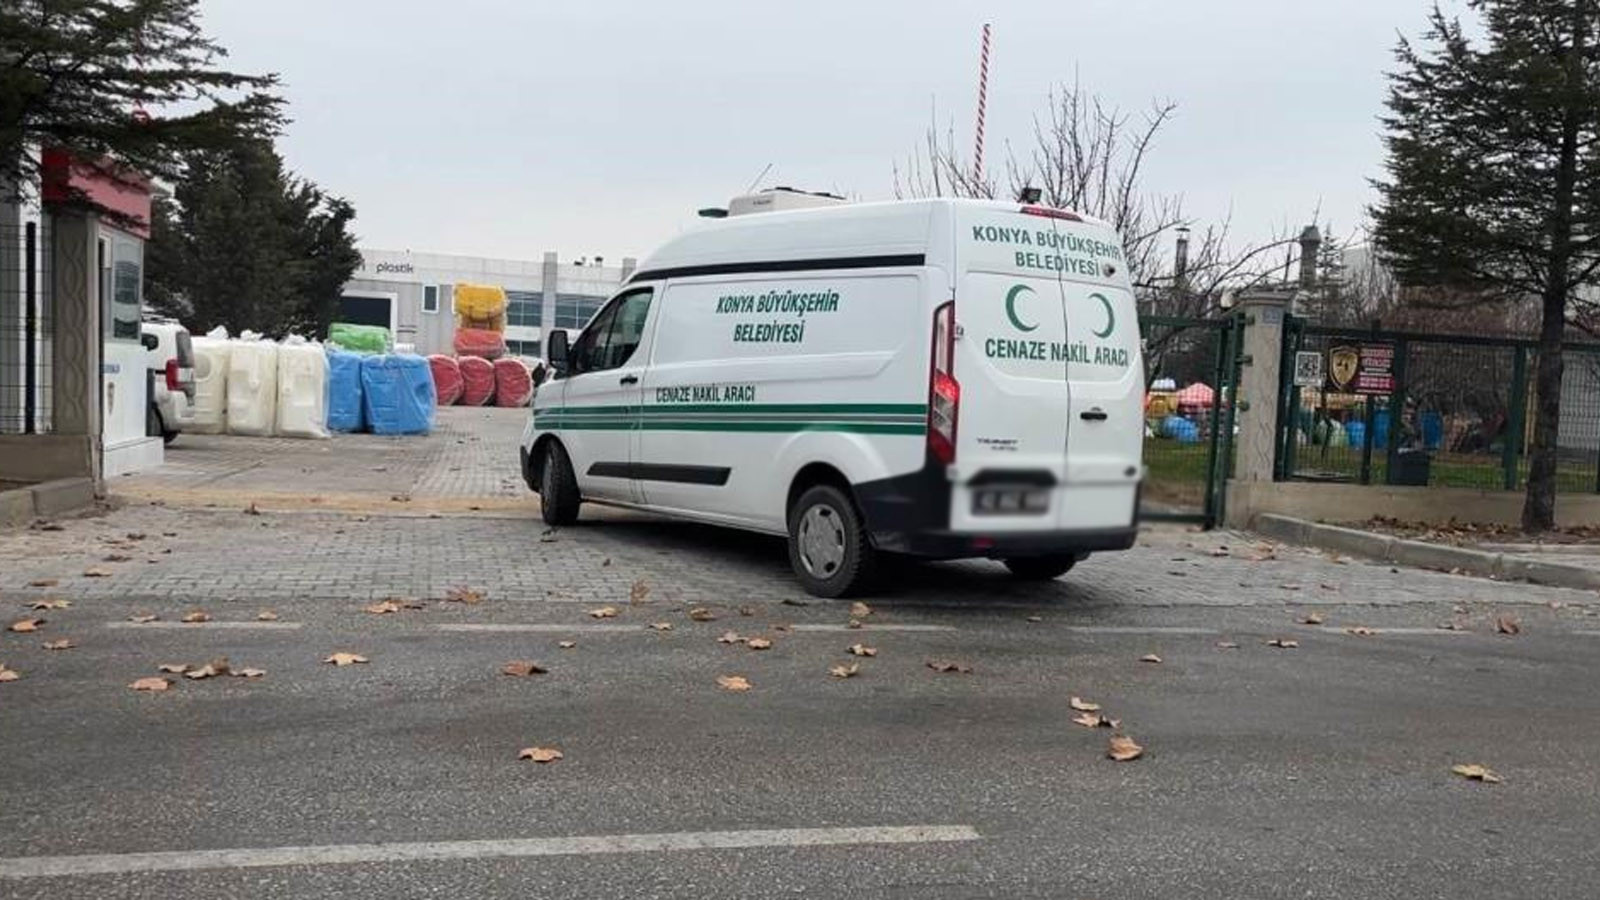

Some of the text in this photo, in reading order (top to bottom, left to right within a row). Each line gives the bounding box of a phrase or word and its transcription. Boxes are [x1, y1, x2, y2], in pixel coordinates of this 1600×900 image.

[972, 225, 1122, 261] KONYA BÜYÜKŞEHİR
[1015, 252, 1100, 277] BELEDİYESİ
[715, 288, 840, 317] KONYA BÜYÜKŞEHİR
[733, 320, 806, 342] BELEDİYESİ
[985, 338, 1129, 368] CENAZE NAKİL ARACI
[655, 383, 756, 403] CENAZE NAKİL ARACI
